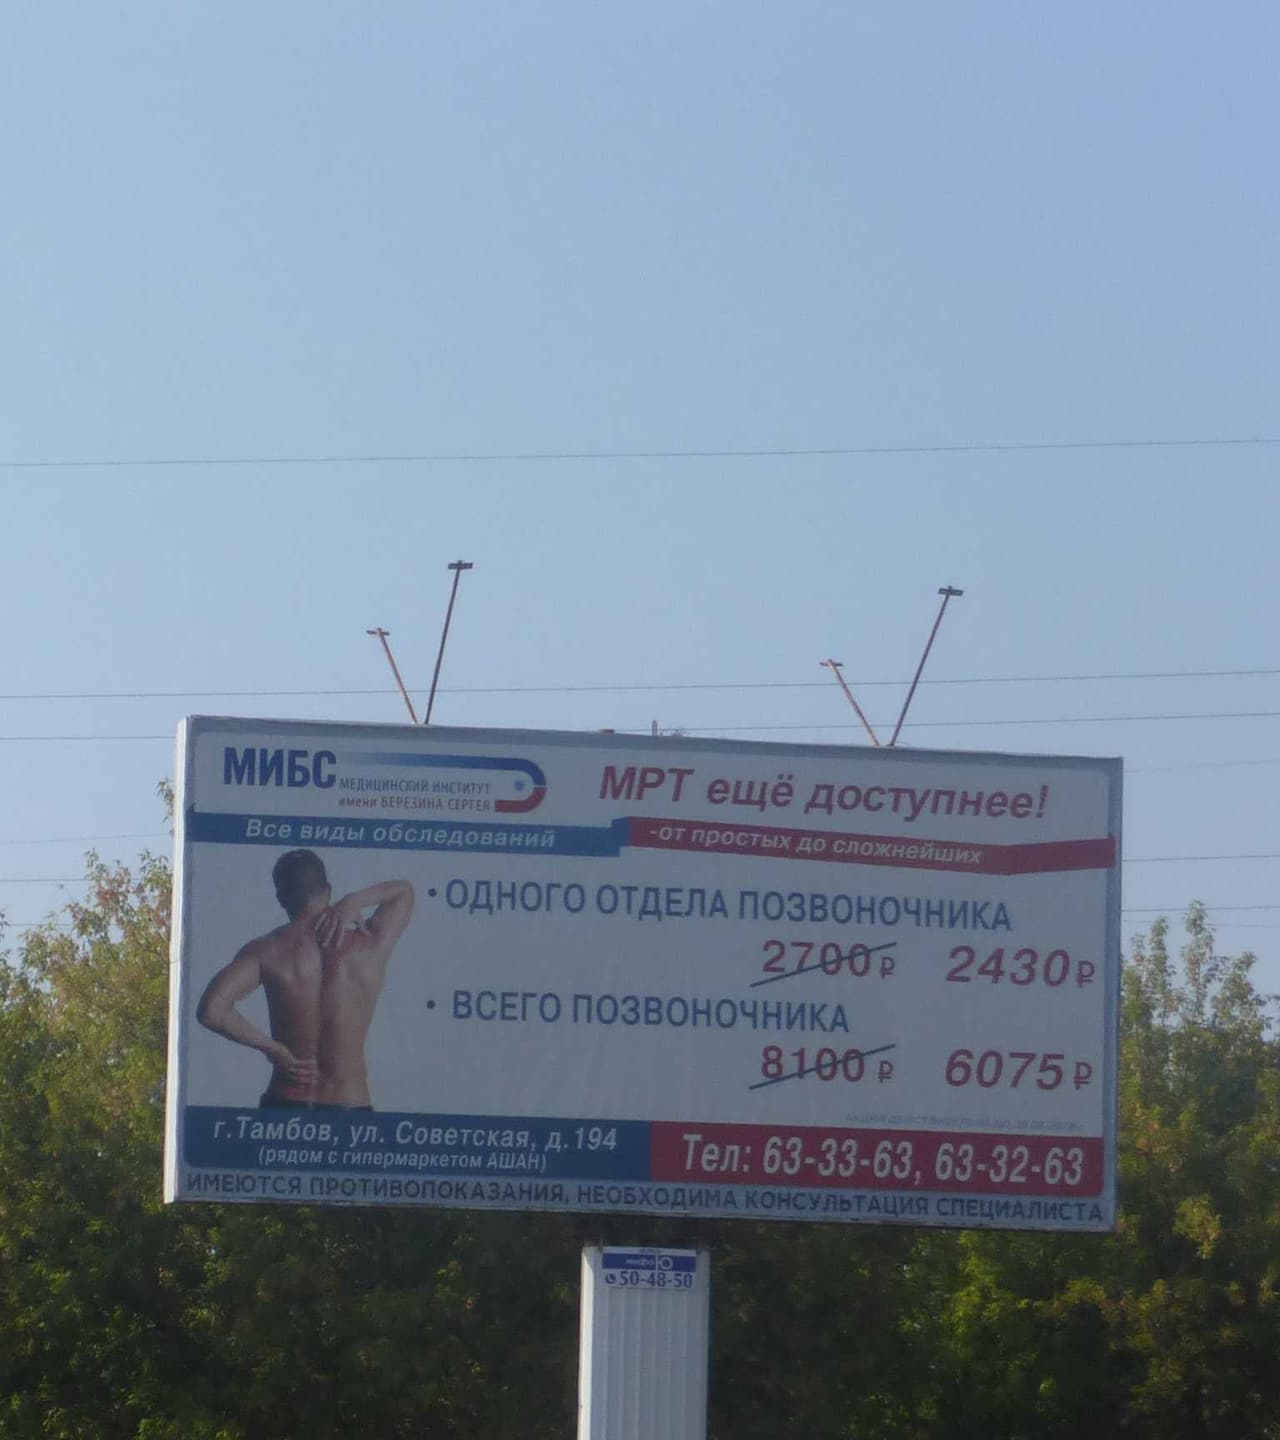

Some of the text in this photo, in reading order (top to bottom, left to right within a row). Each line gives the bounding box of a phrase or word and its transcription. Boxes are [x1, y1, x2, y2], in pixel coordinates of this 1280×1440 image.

[223, 747, 337, 789] МИБС
[339, 777, 490, 795] МЕДИЦИНСКИЙ ИНСТИТУТ
[380, 796, 443, 810] БЕРЕЗИНА
[599, 765, 1049, 823] МРТ ещё доступнее!
[245, 818, 556, 848] Все виды обследований
[691, 827, 790, 851] простых
[795, 836, 827, 856] до
[832, 837, 985, 866] сложнейших
[445, 878, 1014, 931] ОДНОГО ОТДЕЛА ПОЗВОНОЧНИКА
[452, 989, 850, 1033] ВСЕГО ПОЗВОНОЧНИКА
[349, 1124, 386, 1146] ул.
[395, 1120, 537, 1151] Советская,
[257, 1146, 548, 1174] (рядом с гипермаркетом АШАН)
[682, 1133, 1085, 1187] Тел: 63-33-63, 63-32-63
[186, 1174, 302, 1196] ИМЕЮТСЯ
[577, 1184, 739, 1210] НЕОБХОДИМА
[743, 1189, 931, 1219] КОНСУЛЬТАЦИЯ
[935, 1197, 1105, 1223] СПЕЦИАЛИСТА
[619, 1271, 693, 1289] 50-48-50
